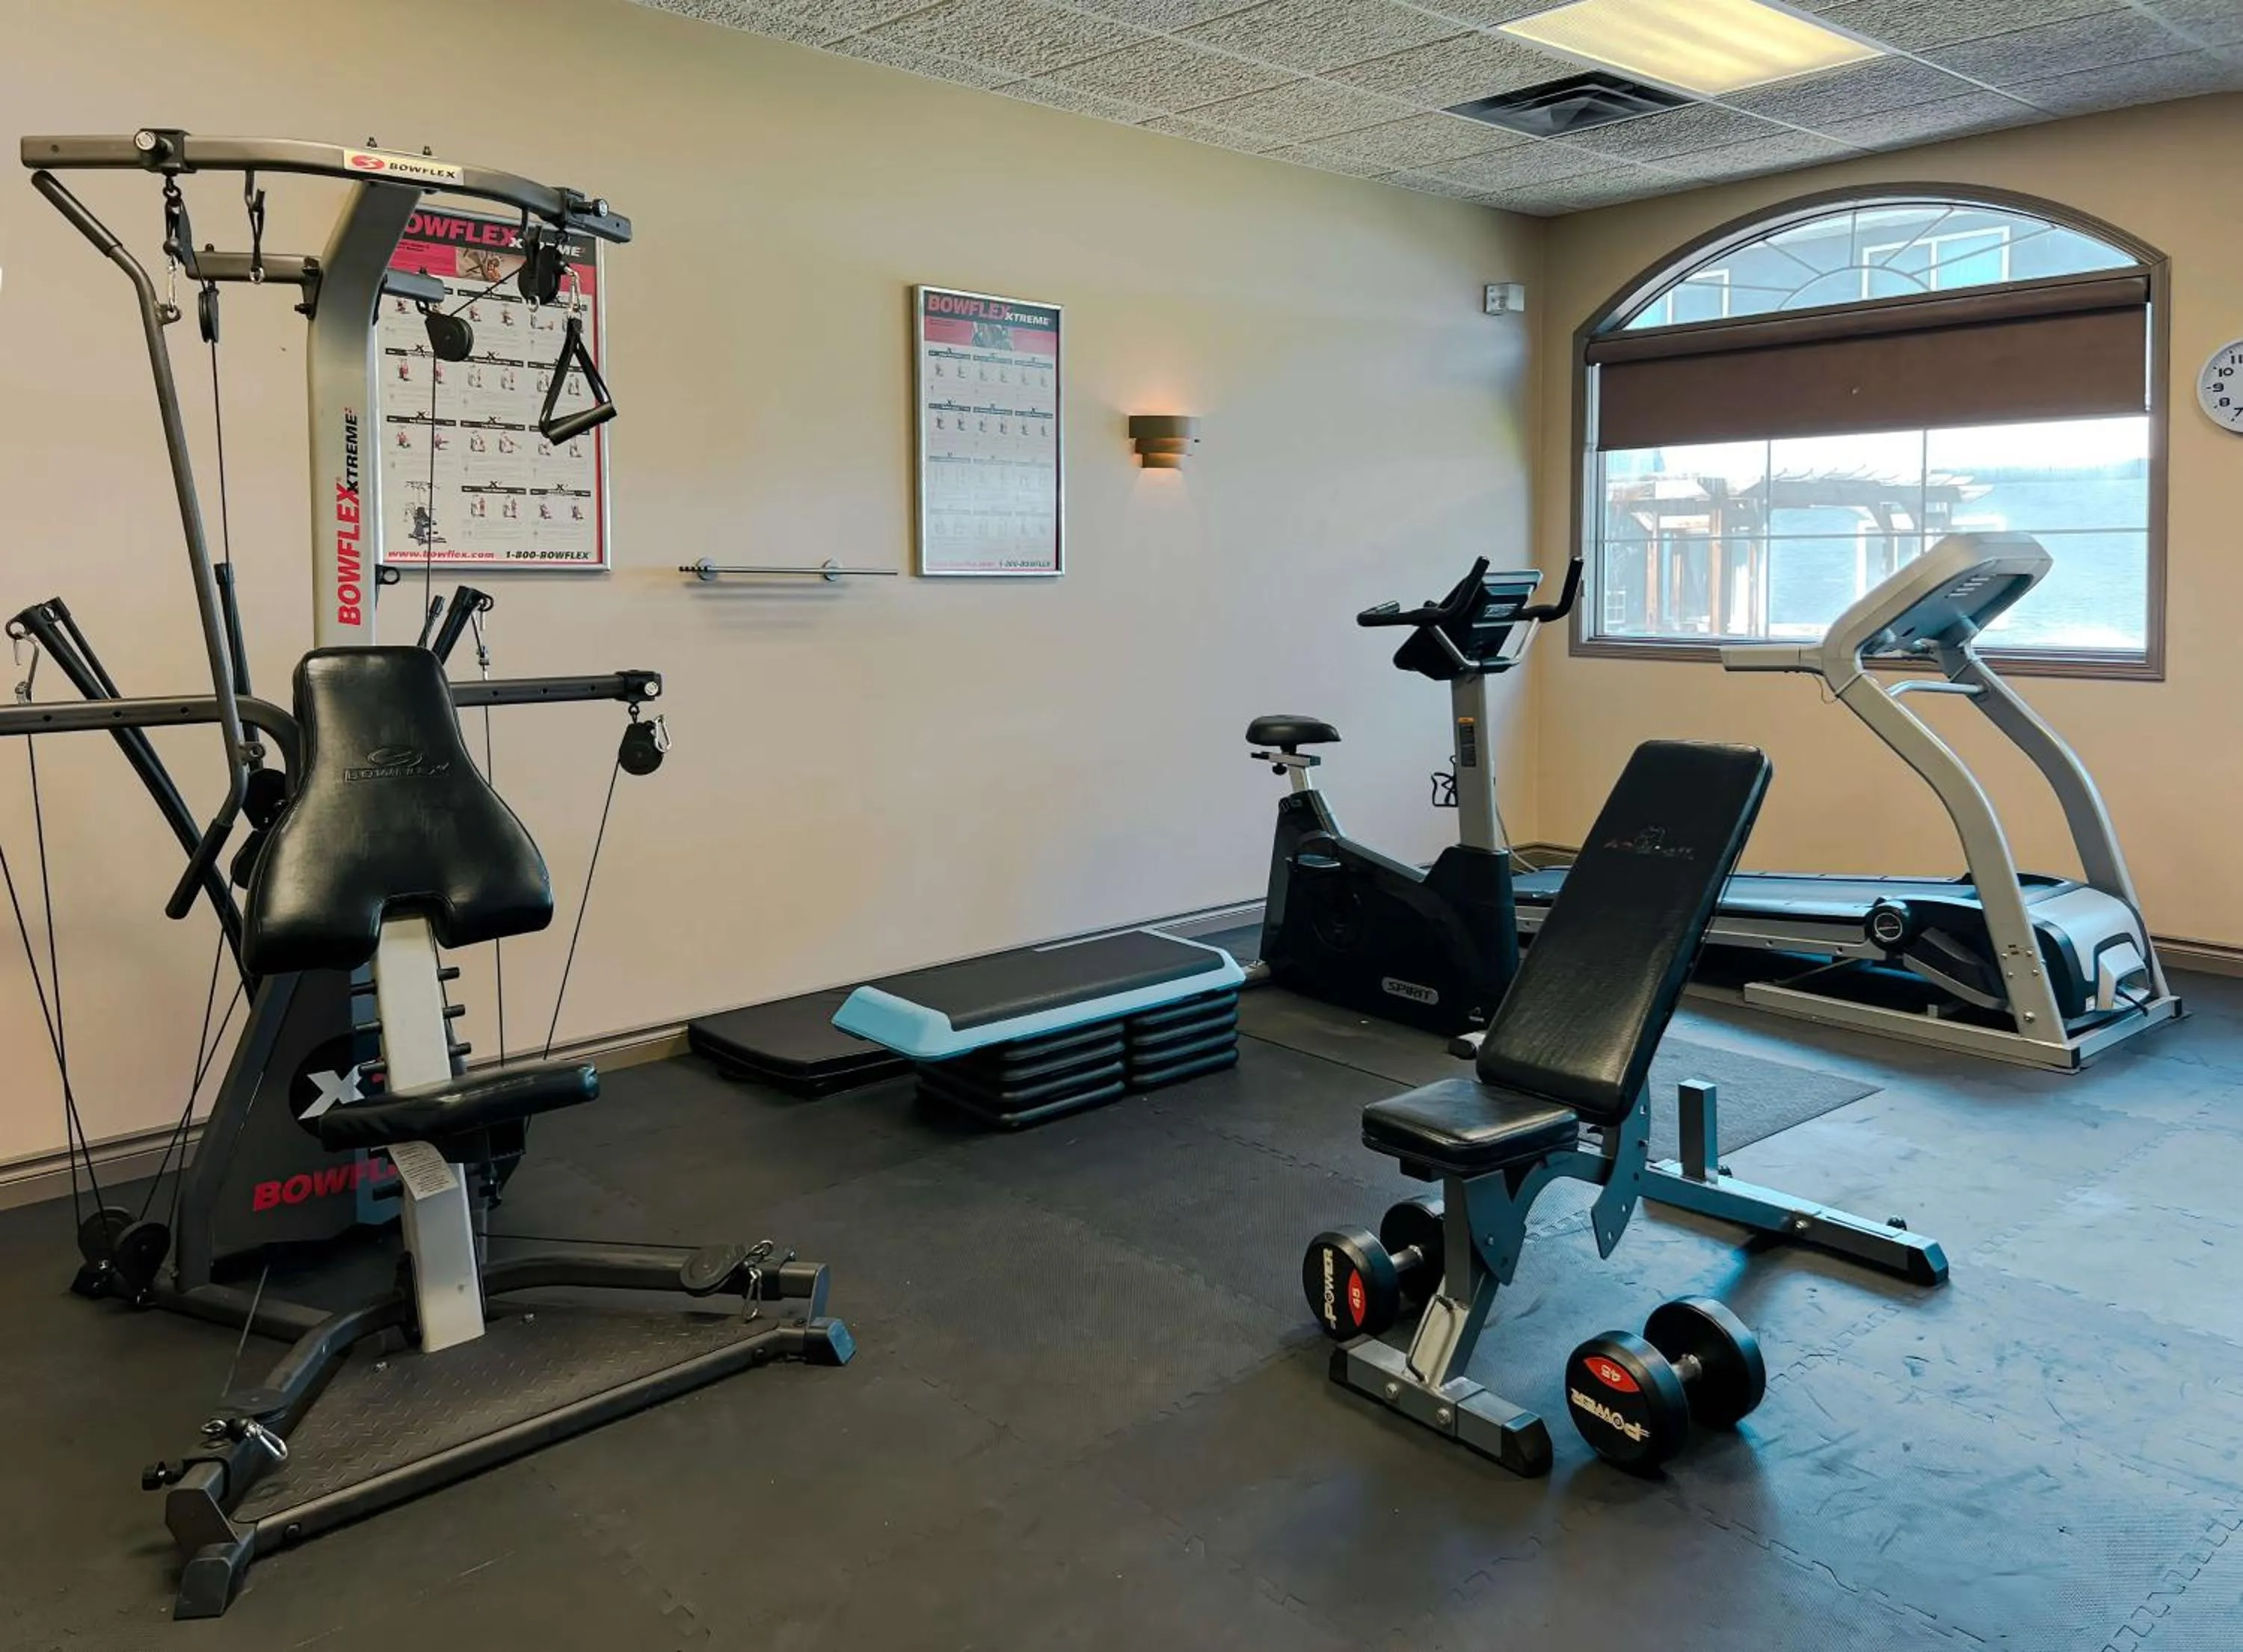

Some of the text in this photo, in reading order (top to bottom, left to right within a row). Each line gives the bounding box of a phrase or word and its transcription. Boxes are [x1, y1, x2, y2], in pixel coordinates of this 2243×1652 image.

[389, 162, 455, 179] BOWFLEX
[406, 214, 520, 247] OWFLEX
[928, 295, 1049, 326] BOWFLEX XTREME
[2231, 354, 2243, 364] 11
[2218, 367, 2234, 377] 10
[2212, 383, 2224, 392] 9
[2219, 397, 2230, 407] 8
[337, 482, 361, 626] BOWFLEX
[388, 549, 590, 561] www.bowflex.com 1-800-BOWFLEX
[252, 1157, 398, 1212] BOWFL
[1323, 1248, 1337, 1325] POWER
[1352, 1286, 1361, 1309] 45
[1571, 1387, 1646, 1442] POWER
